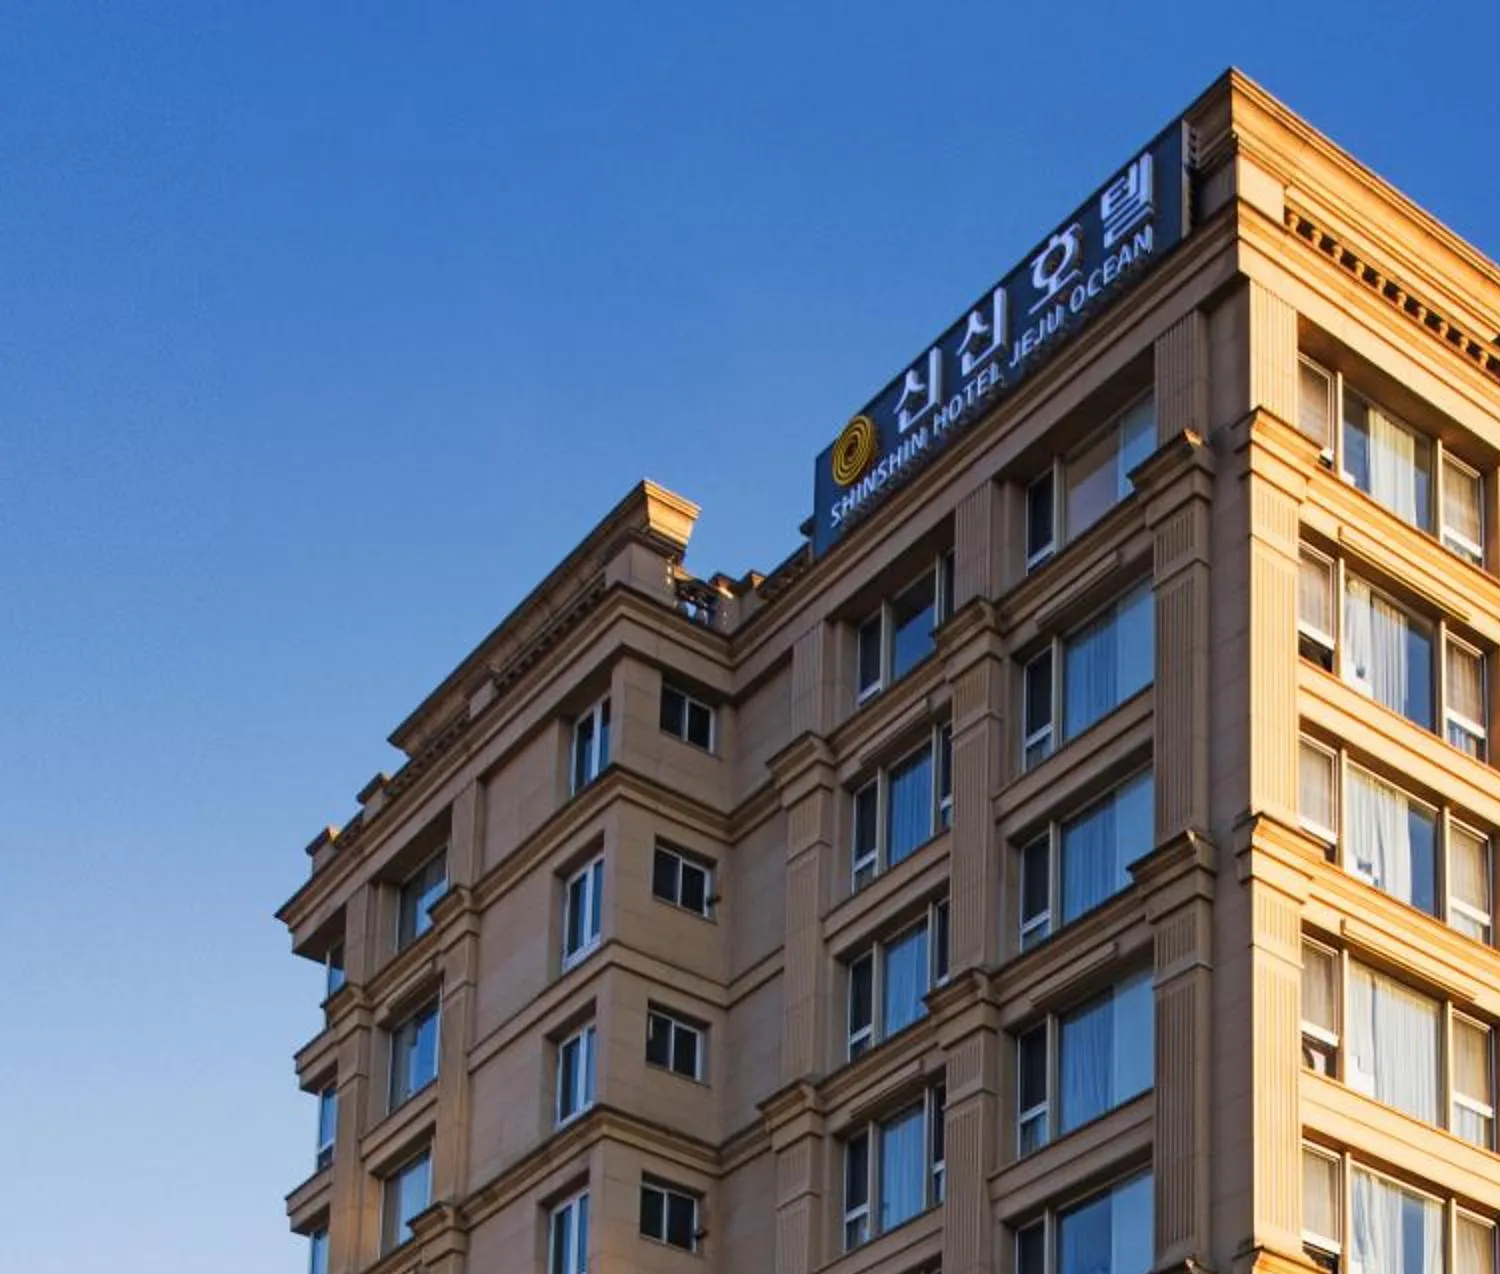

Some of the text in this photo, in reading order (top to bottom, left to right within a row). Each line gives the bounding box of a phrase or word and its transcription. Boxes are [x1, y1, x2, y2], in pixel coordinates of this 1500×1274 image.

[830, 224, 1154, 528] SHINSHIN HOTEL JEJU OCEAN
[894, 152, 1154, 433] 신신호텔
